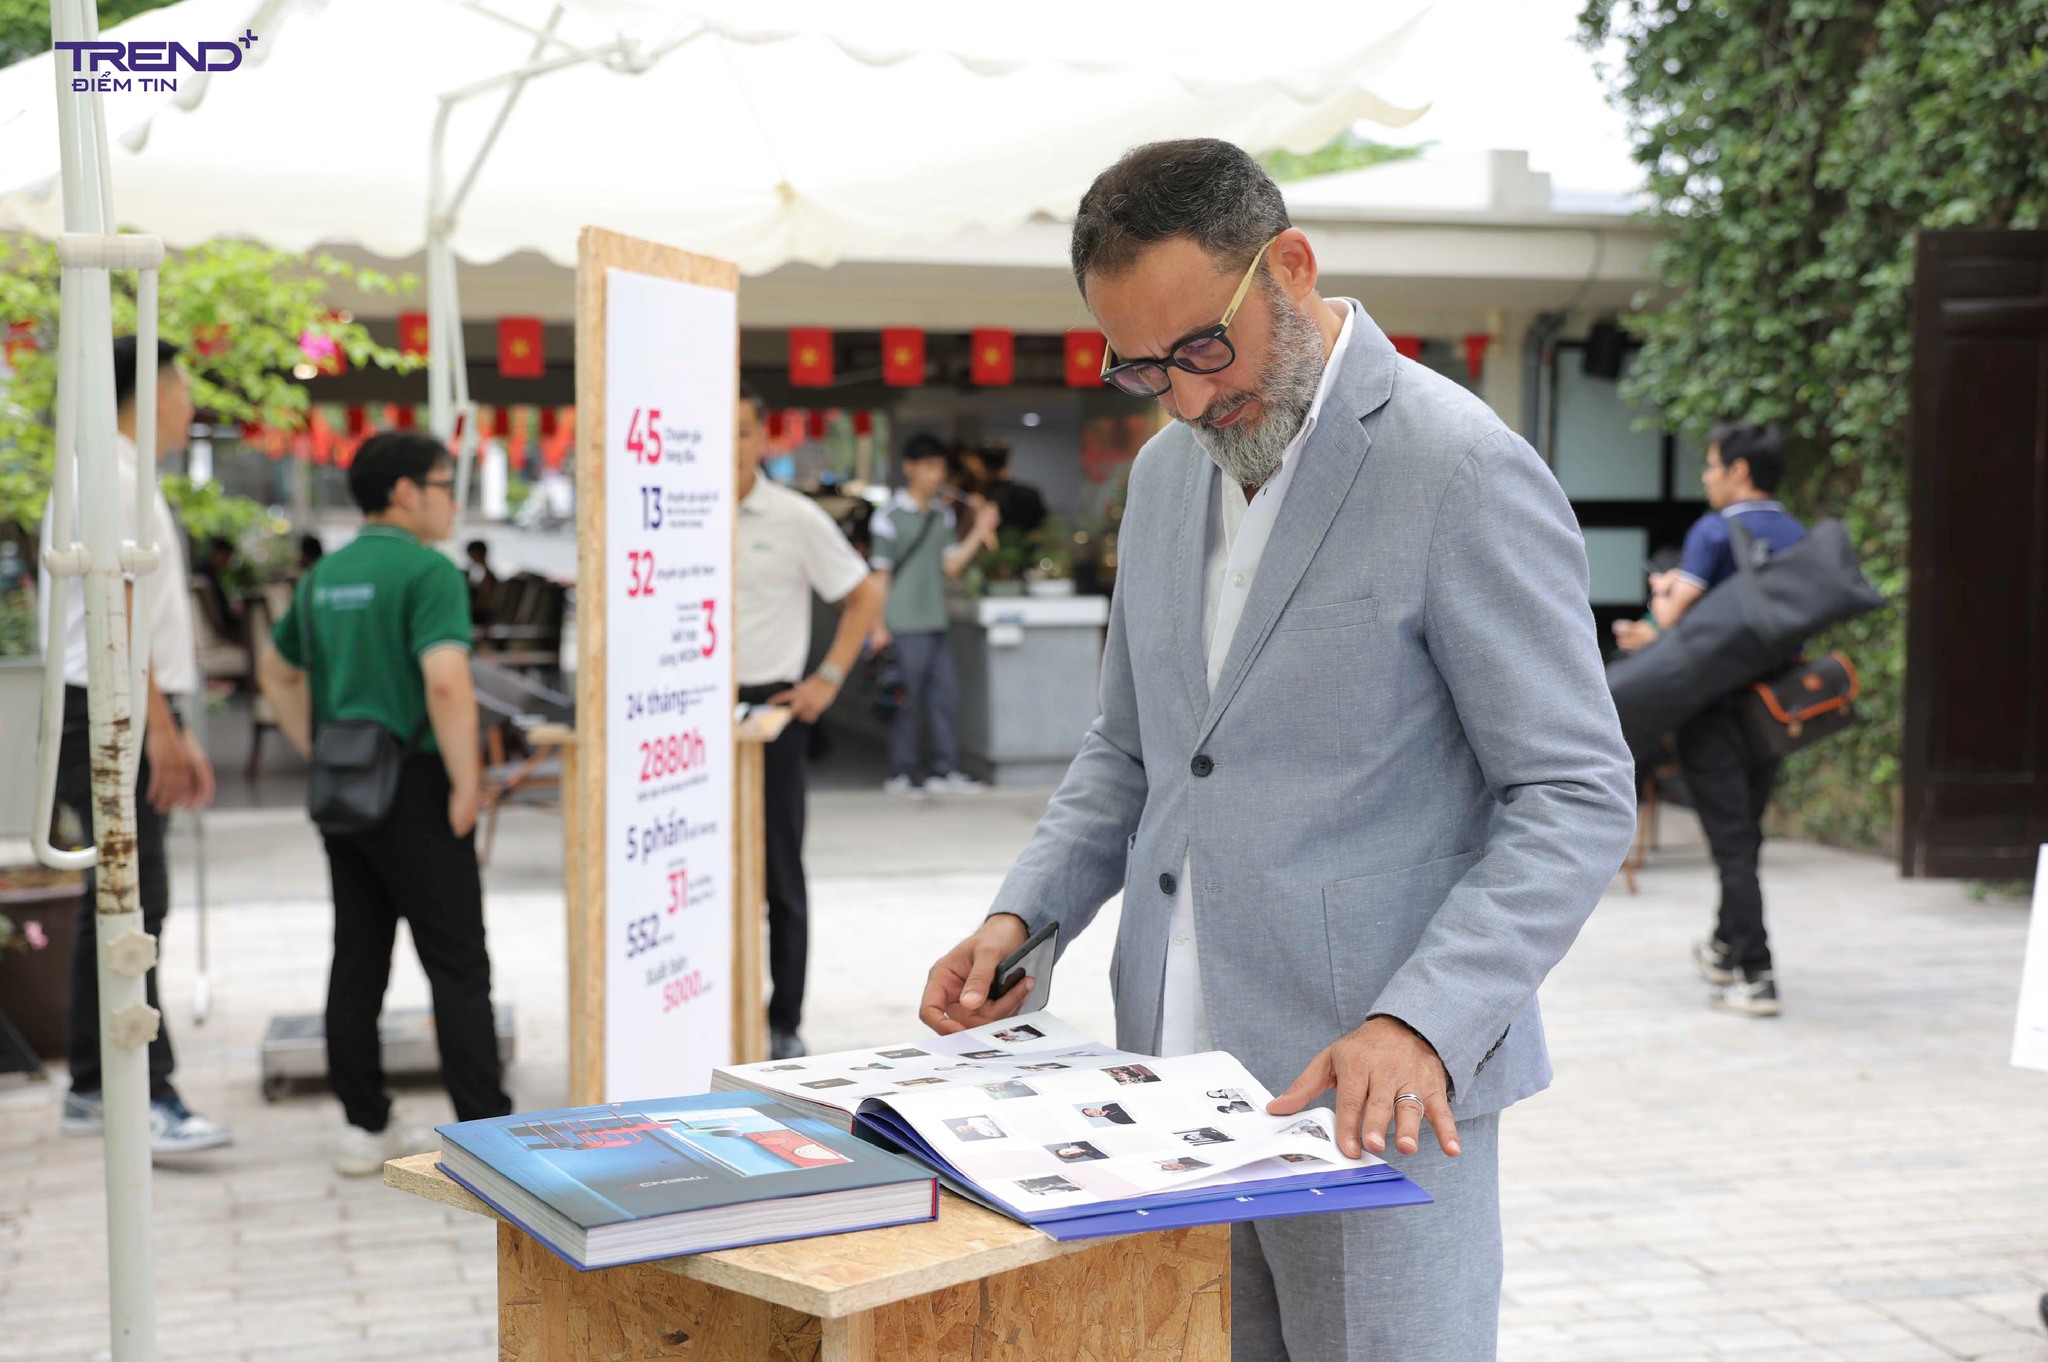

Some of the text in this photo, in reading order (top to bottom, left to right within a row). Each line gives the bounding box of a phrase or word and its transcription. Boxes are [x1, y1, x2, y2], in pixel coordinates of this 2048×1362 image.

[627, 408, 661, 464] 45
[641, 486, 662, 530] 13
[628, 551, 654, 597] 32
[702, 600, 717, 657] 3
[640, 726, 706, 782] 2880h
[626, 825, 638, 861] 5
[667, 868, 689, 915] 31
[626, 912, 660, 958] 552
[663, 969, 702, 1014] 5000
